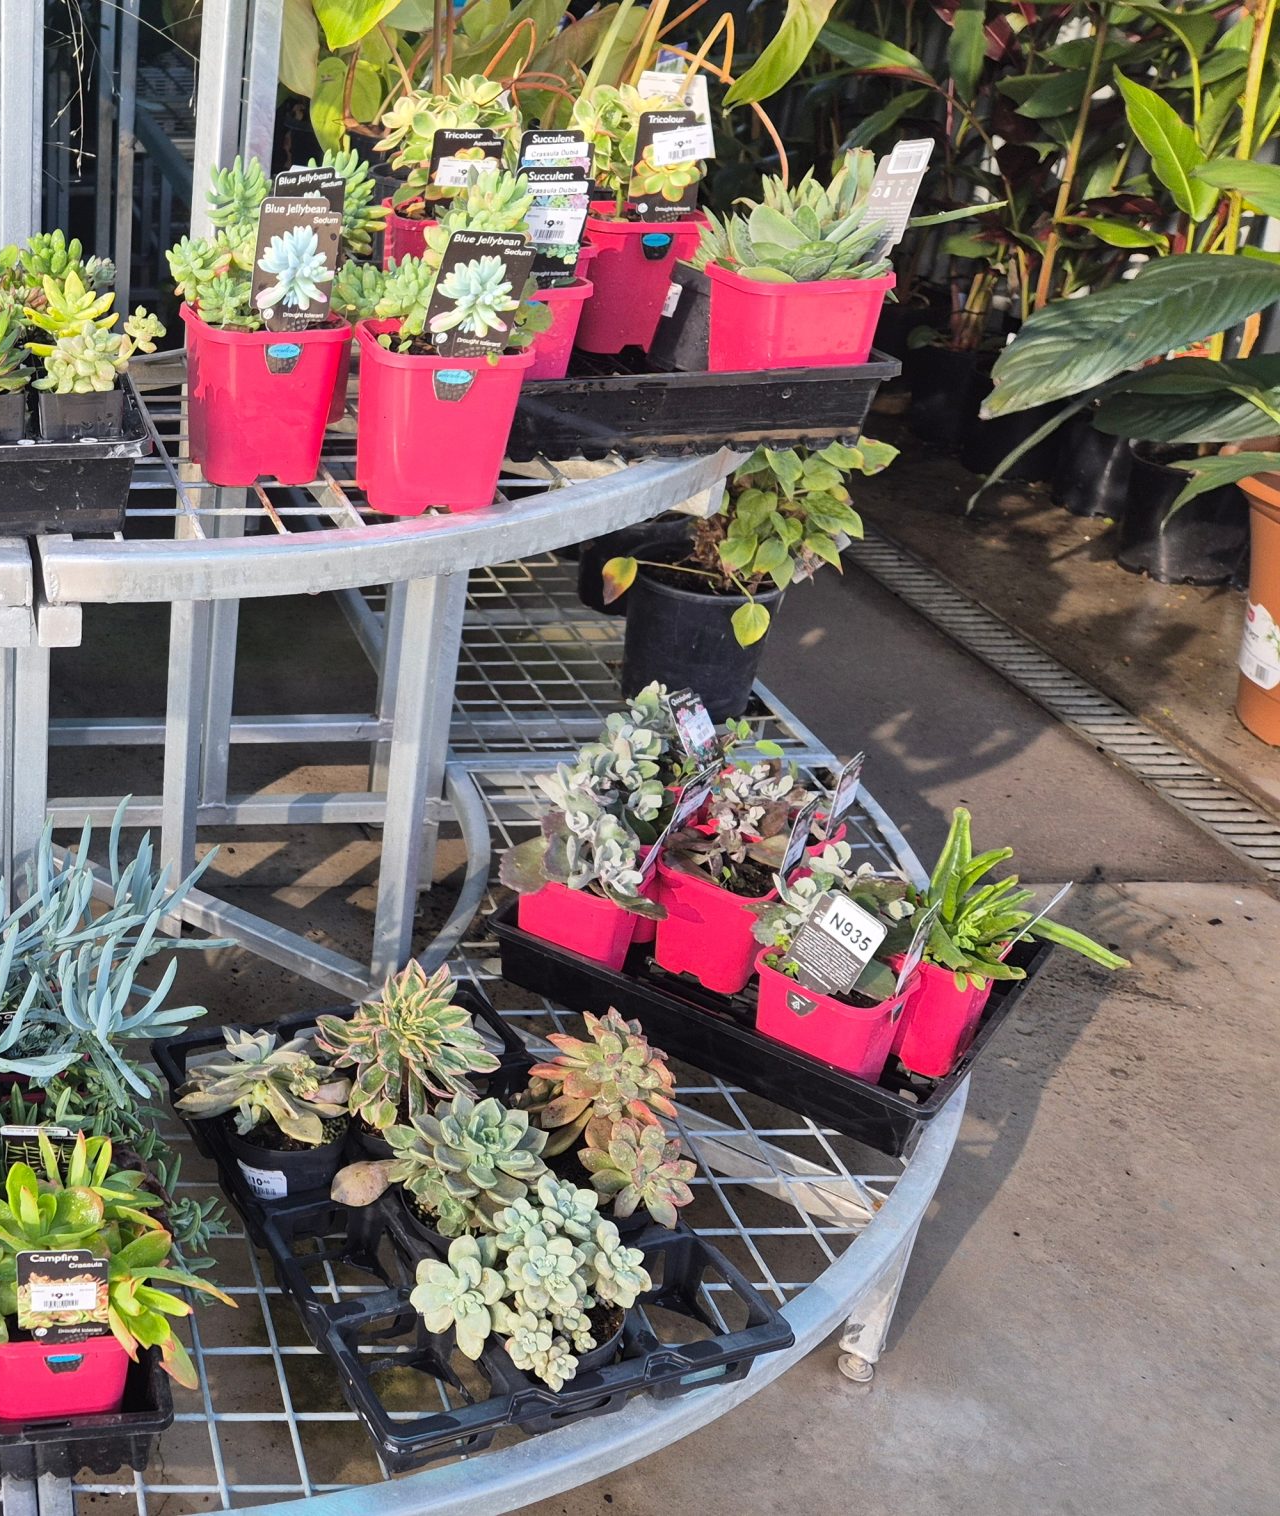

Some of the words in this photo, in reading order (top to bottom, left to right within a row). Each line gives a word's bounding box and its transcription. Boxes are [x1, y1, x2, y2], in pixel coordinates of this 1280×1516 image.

[648, 115, 686, 123] Tricolour
[444, 131, 483, 139] Tricolour
[532, 134, 574, 143] Succulent
[278, 176, 296, 185] Blue
[297, 172, 332, 185] Jellybean
[528, 172, 574, 180] Succulent
[265, 203, 285, 213] Blue
[286, 204, 326, 216] Jellybean
[313, 216, 338, 224] Sedum
[453, 234, 476, 243] Blue
[476, 235, 520, 246] Jellybean
[504, 248, 531, 256] Sedum
[457, 337, 479, 345] Drought
[829, 912, 872, 951] N935
[30, 1254, 78, 1264] Campfire
